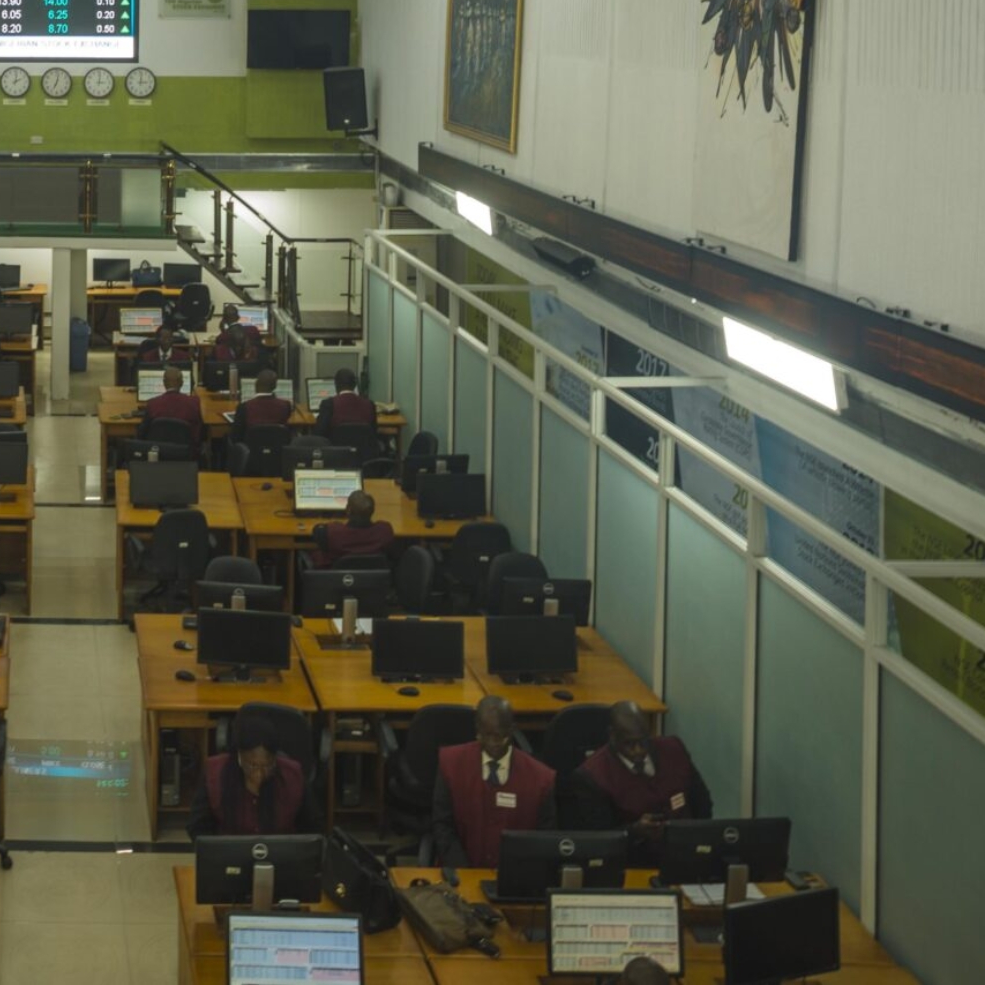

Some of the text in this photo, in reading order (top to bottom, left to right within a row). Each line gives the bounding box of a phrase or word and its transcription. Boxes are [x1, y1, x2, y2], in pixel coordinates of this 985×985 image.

[1, 10, 22, 19] 6.05
[96, 11, 115, 19] 0.20
[48, 24, 68, 33] 8.70
[732, 483, 748, 511] 20
[963, 534, 985, 561] 20
